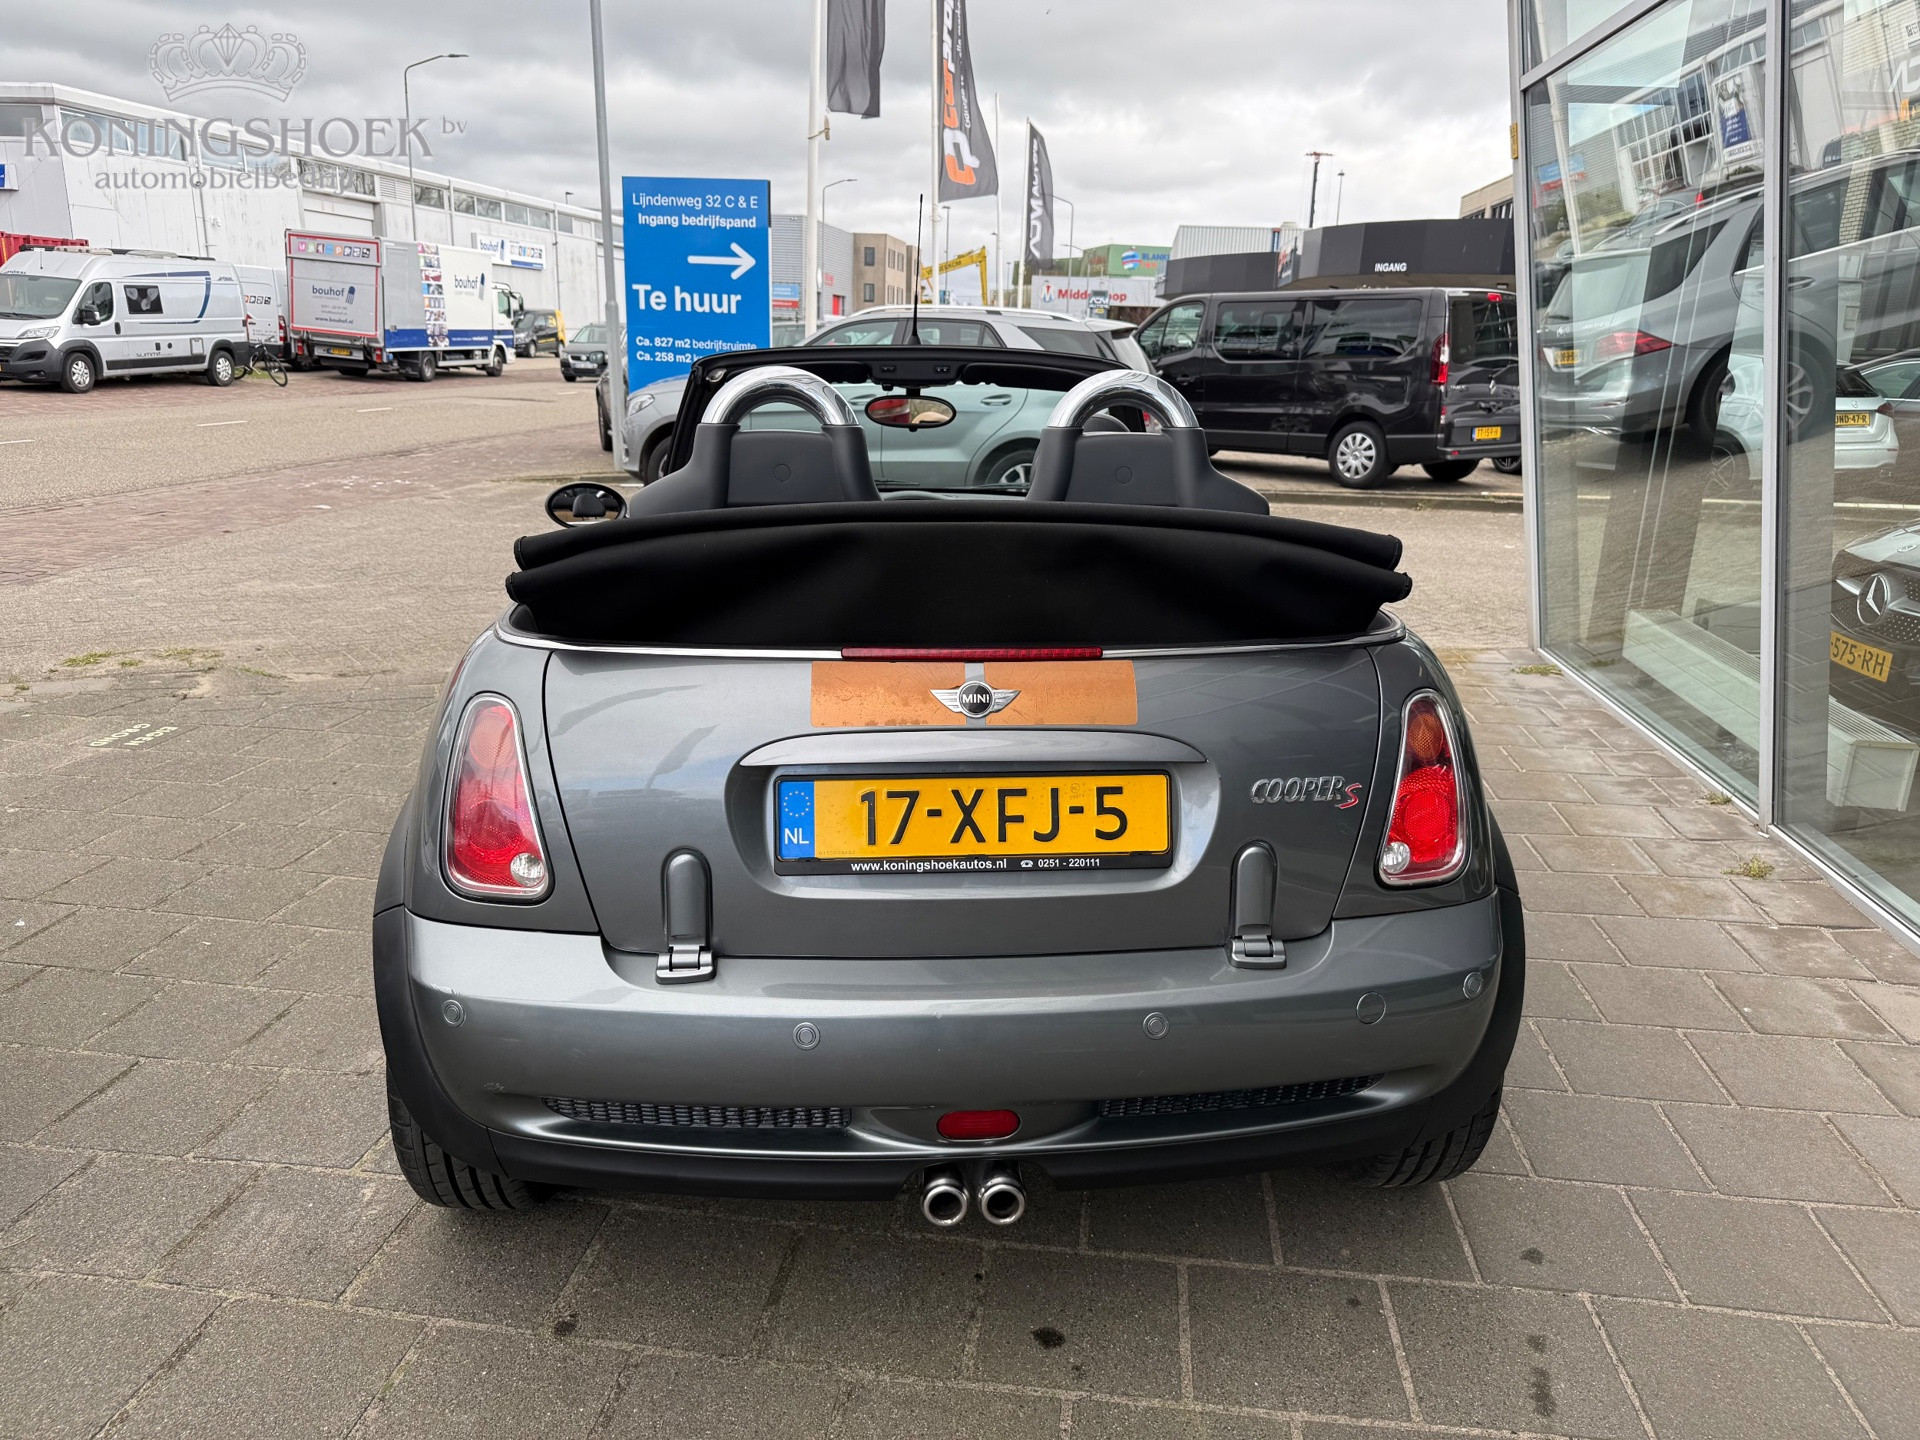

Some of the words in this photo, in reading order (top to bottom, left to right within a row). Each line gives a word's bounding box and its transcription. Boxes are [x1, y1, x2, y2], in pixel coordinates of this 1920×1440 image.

[632, 193, 702, 210] Lijndenweg
[705, 195, 722, 208] 32
[725, 196, 735, 208] C
[738, 196, 747, 208] &
[750, 196, 759, 209] E
[638, 213, 679, 228] Ingang
[682, 214, 757, 230] bedrijfspand
[479, 239, 500, 252] bouhof
[1374, 262, 1407, 272] INGANG
[454, 274, 478, 290] bouhof
[312, 285, 345, 297] bouhof
[632, 284, 667, 311] Te
[674, 285, 742, 314] huur
[636, 336, 652, 347] Ca.
[654, 337, 673, 347] 827
[675, 339, 691, 348] m2
[692, 339, 757, 351] bedrijfsruimte
[636, 351, 654, 361] Ca.
[655, 352, 674, 362] 258
[676, 354, 692, 363] m2
[962, 693, 990, 704] MINI
[1250, 776, 1346, 803] COOPER
[1335, 783, 1363, 809] S
[860, 786, 1128, 846] 17-XFJ-5
[784, 827, 810, 845] NL
[850, 858, 1007, 872] www.koningshoekautos.nl
[1038, 859, 1060, 867] 0251
[1069, 858, 1100, 867] 220111
